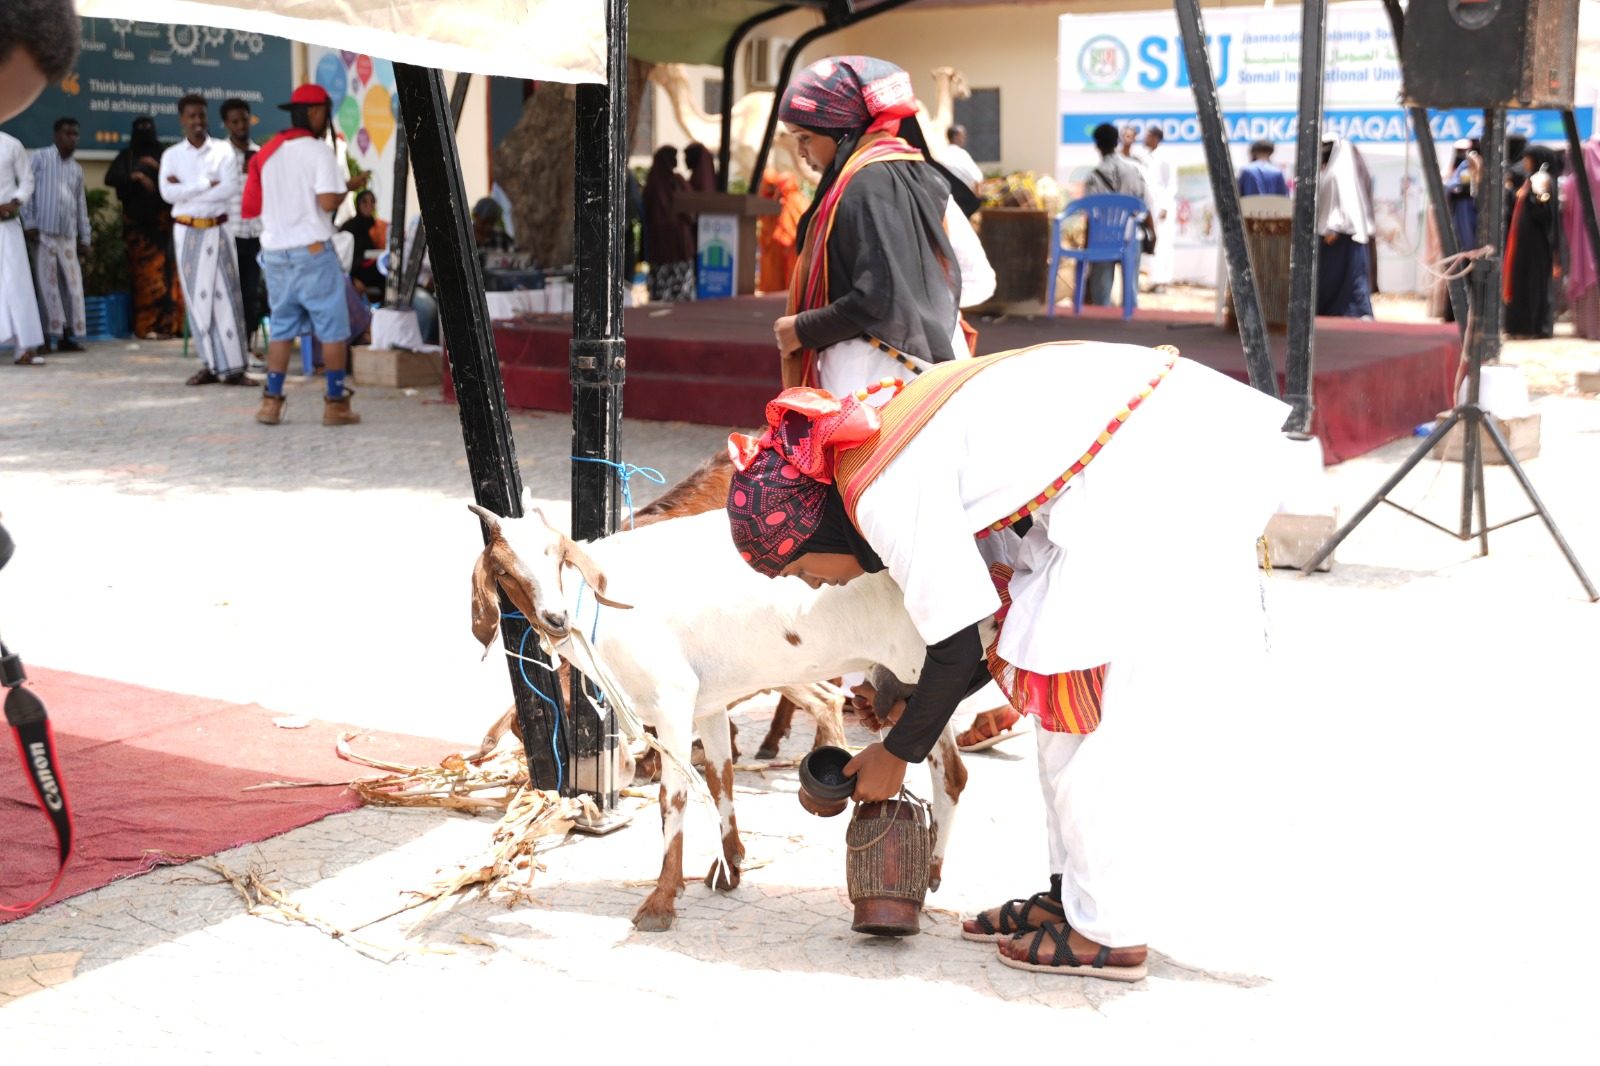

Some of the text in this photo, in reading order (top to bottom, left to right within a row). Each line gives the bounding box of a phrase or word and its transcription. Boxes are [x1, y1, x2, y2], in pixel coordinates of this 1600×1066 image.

[1238, 70, 1280, 83] Somali
[89, 79, 117, 93] Think
[120, 81, 155, 97] beyond
[204, 87, 225, 100] with
[89, 98, 109, 111] and
[111, 99, 149, 112] achieve
[29, 742, 63, 812] Canon
